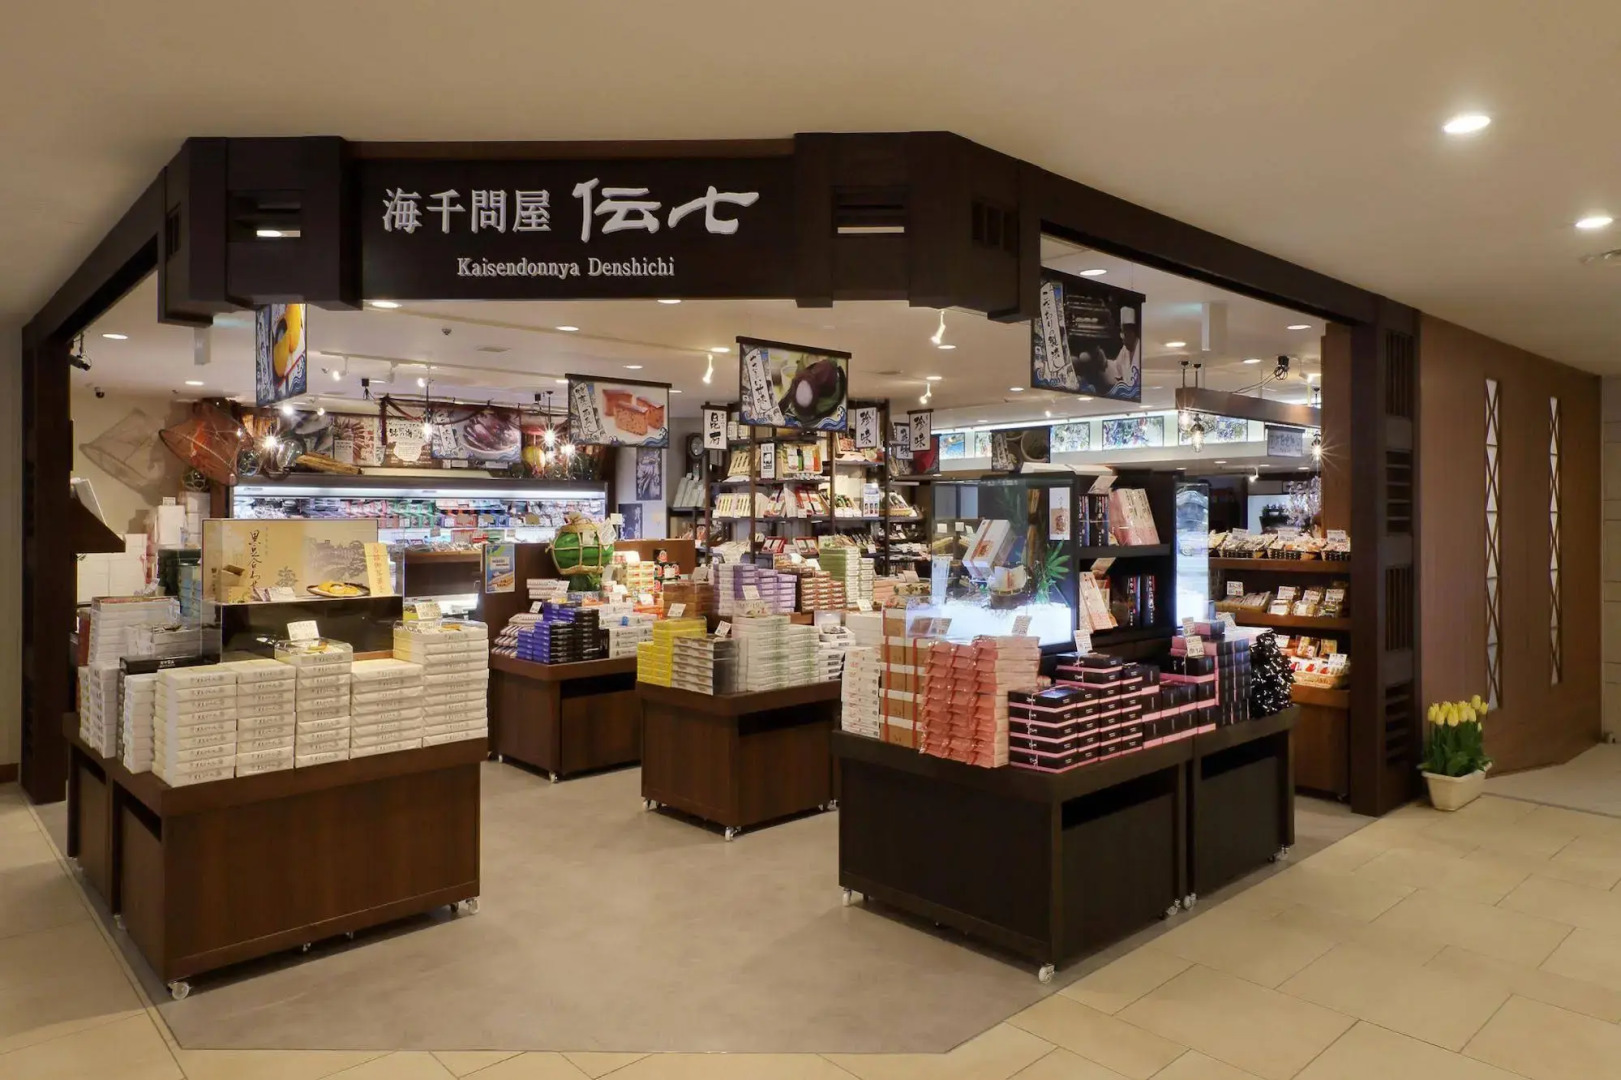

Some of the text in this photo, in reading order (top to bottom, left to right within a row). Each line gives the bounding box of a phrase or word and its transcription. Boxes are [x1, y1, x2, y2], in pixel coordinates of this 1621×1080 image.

[382, 177, 760, 243] 海千問屋 伝七
[456, 256, 675, 280] Kaisendonnya Denshichi
[709, 411, 721, 446] 昆布
